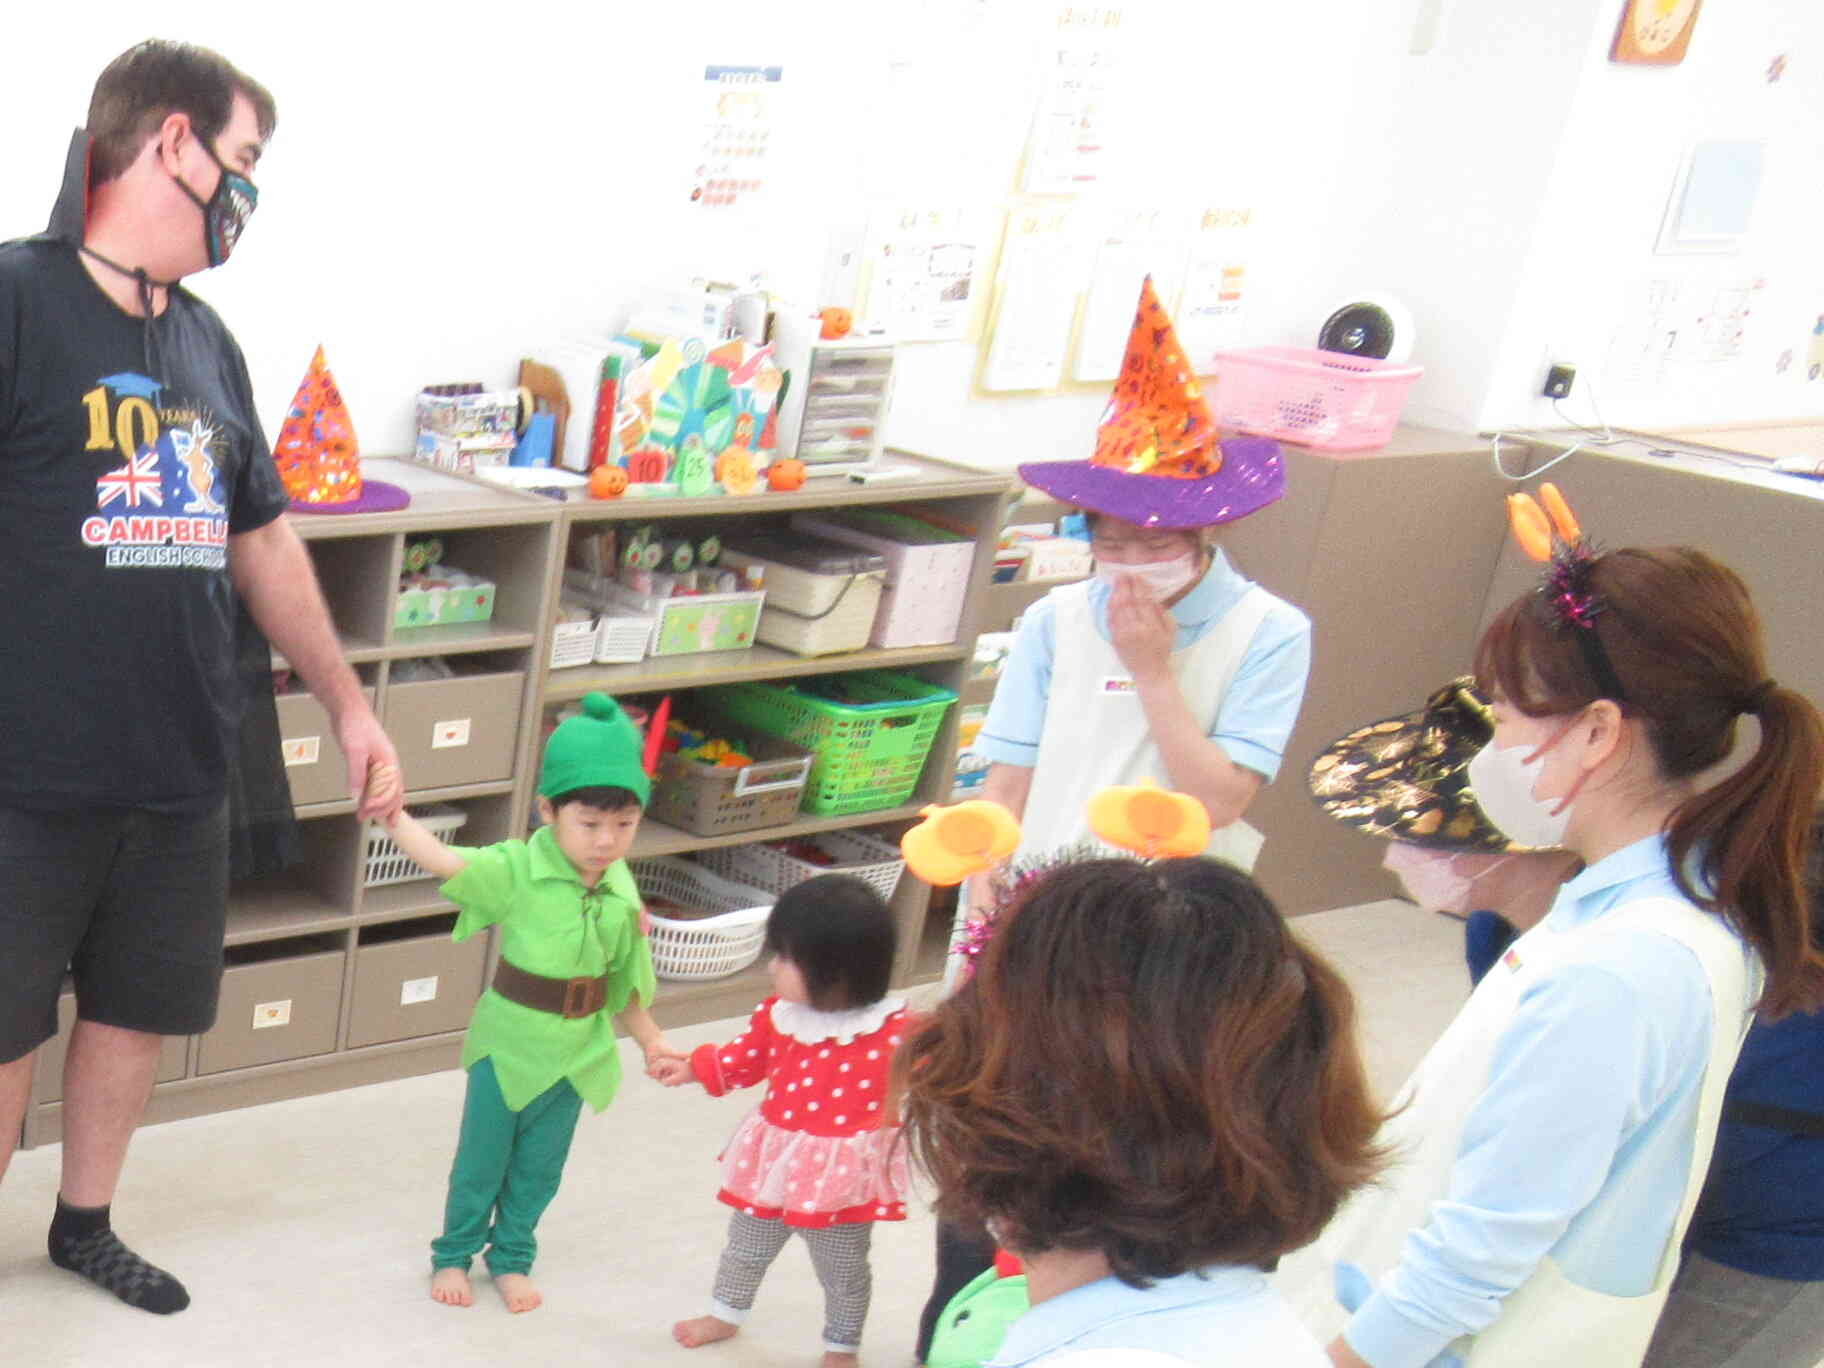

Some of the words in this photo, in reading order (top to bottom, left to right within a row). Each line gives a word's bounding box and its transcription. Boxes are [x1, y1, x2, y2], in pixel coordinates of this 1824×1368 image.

[81, 386, 160, 460] 10
[81, 515, 227, 548] CAMPBELL
[106, 547, 182, 569] ENGLISH
